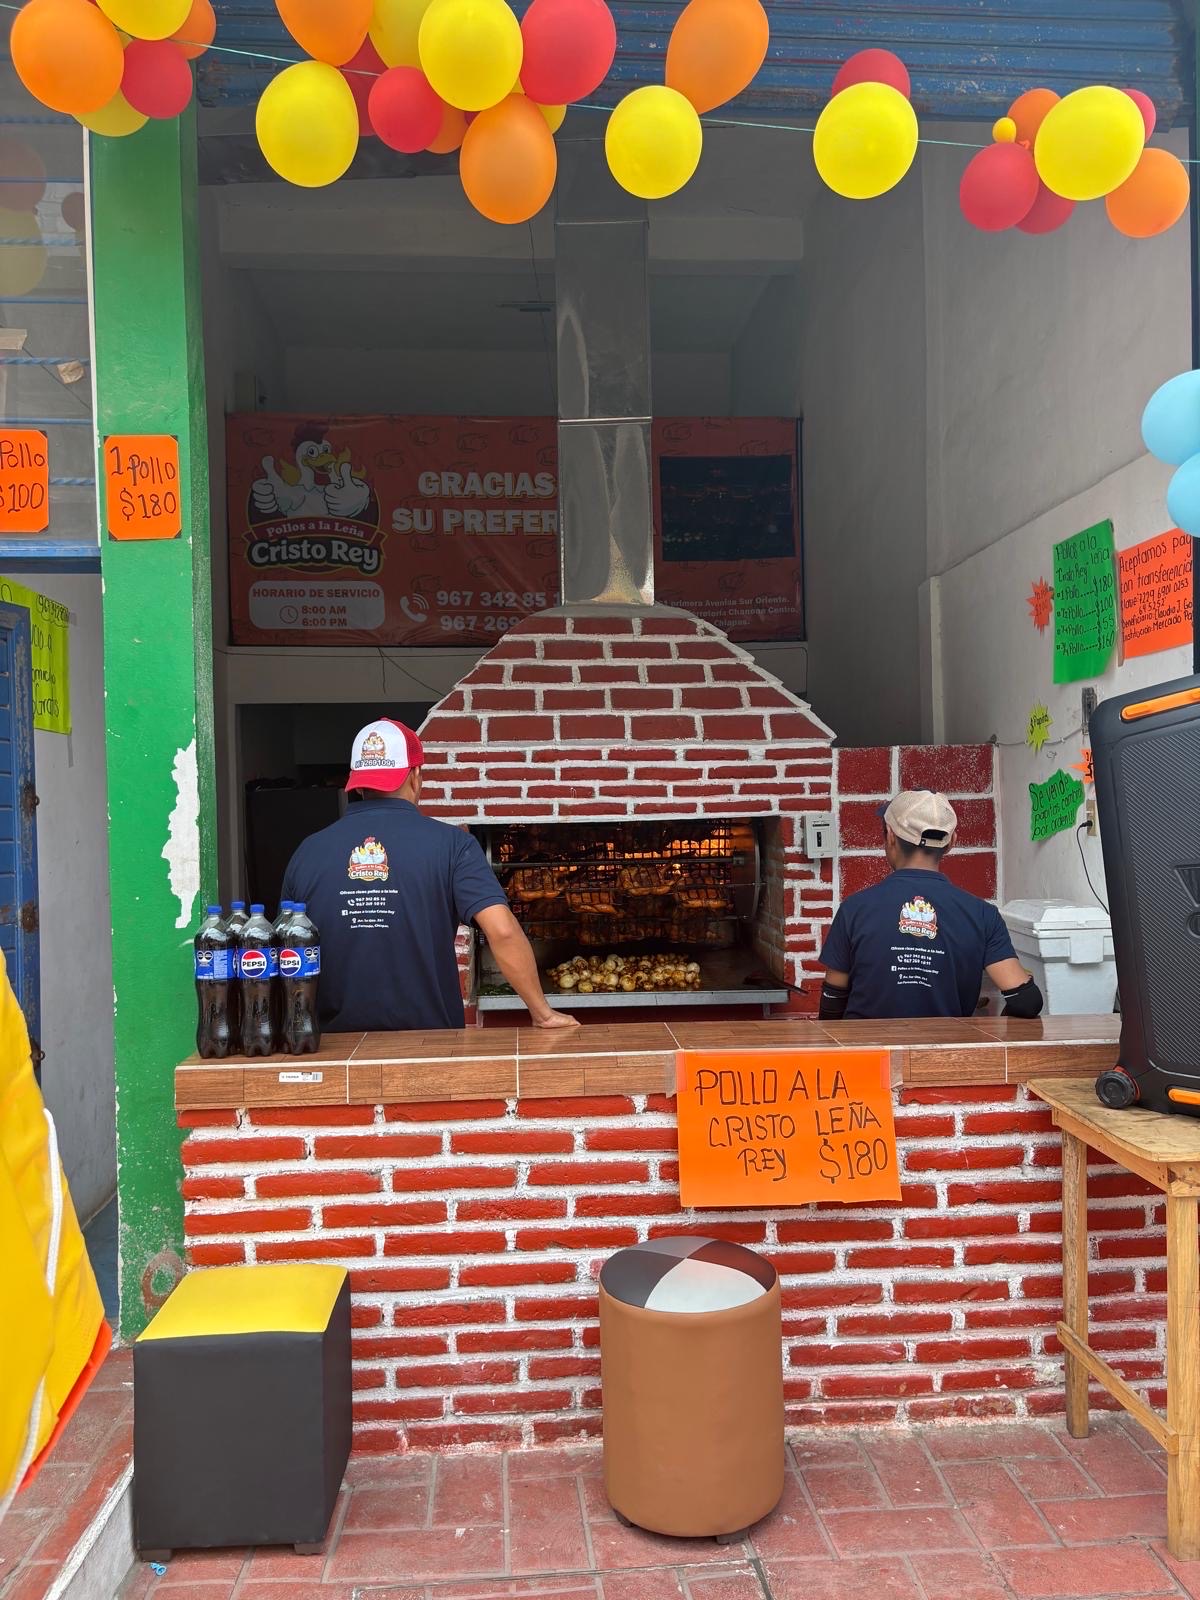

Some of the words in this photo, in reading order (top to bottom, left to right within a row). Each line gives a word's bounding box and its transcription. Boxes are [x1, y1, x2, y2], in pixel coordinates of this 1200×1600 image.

[0, 440, 45, 469] Pollo
[110, 446, 124, 476] 1
[127, 454, 176, 486] Pollo
[418, 471, 557, 498] GRACIAS
[119, 488, 177, 521] $180
[266, 522, 306, 538] Pollos
[308, 521, 316, 530] a
[319, 520, 331, 530] la
[334, 522, 365, 538] Leña
[391, 508, 435, 534] SU
[251, 539, 327, 564] Cristo
[331, 540, 379, 570] Rey
[1119, 541, 1167, 575] Aceptamos
[252, 588, 306, 598] HORARIO
[308, 588, 324, 598] DE
[326, 588, 380, 598] SERVICIO
[435, 591, 474, 606] 967
[479, 591, 517, 606] 342
[522, 591, 547, 607] 85
[1120, 578, 1133, 594] con
[329, 606, 347, 614] AM
[329, 618, 348, 627] PM
[439, 615, 477, 631] 967
[1028, 782, 1045, 812] Se
[1032, 825, 1050, 842] por
[351, 869, 374, 877] Cristo
[374, 870, 387, 879] Rey
[901, 925, 921, 933] Cristo
[921, 927, 935, 937] Rey
[694, 1069, 779, 1106] POLLO
[788, 1069, 810, 1102] A
[816, 1067, 850, 1102] LA
[708, 1113, 796, 1148] CRISTO
[815, 1101, 883, 1137] LEÑA
[818, 1137, 889, 1185] $180
